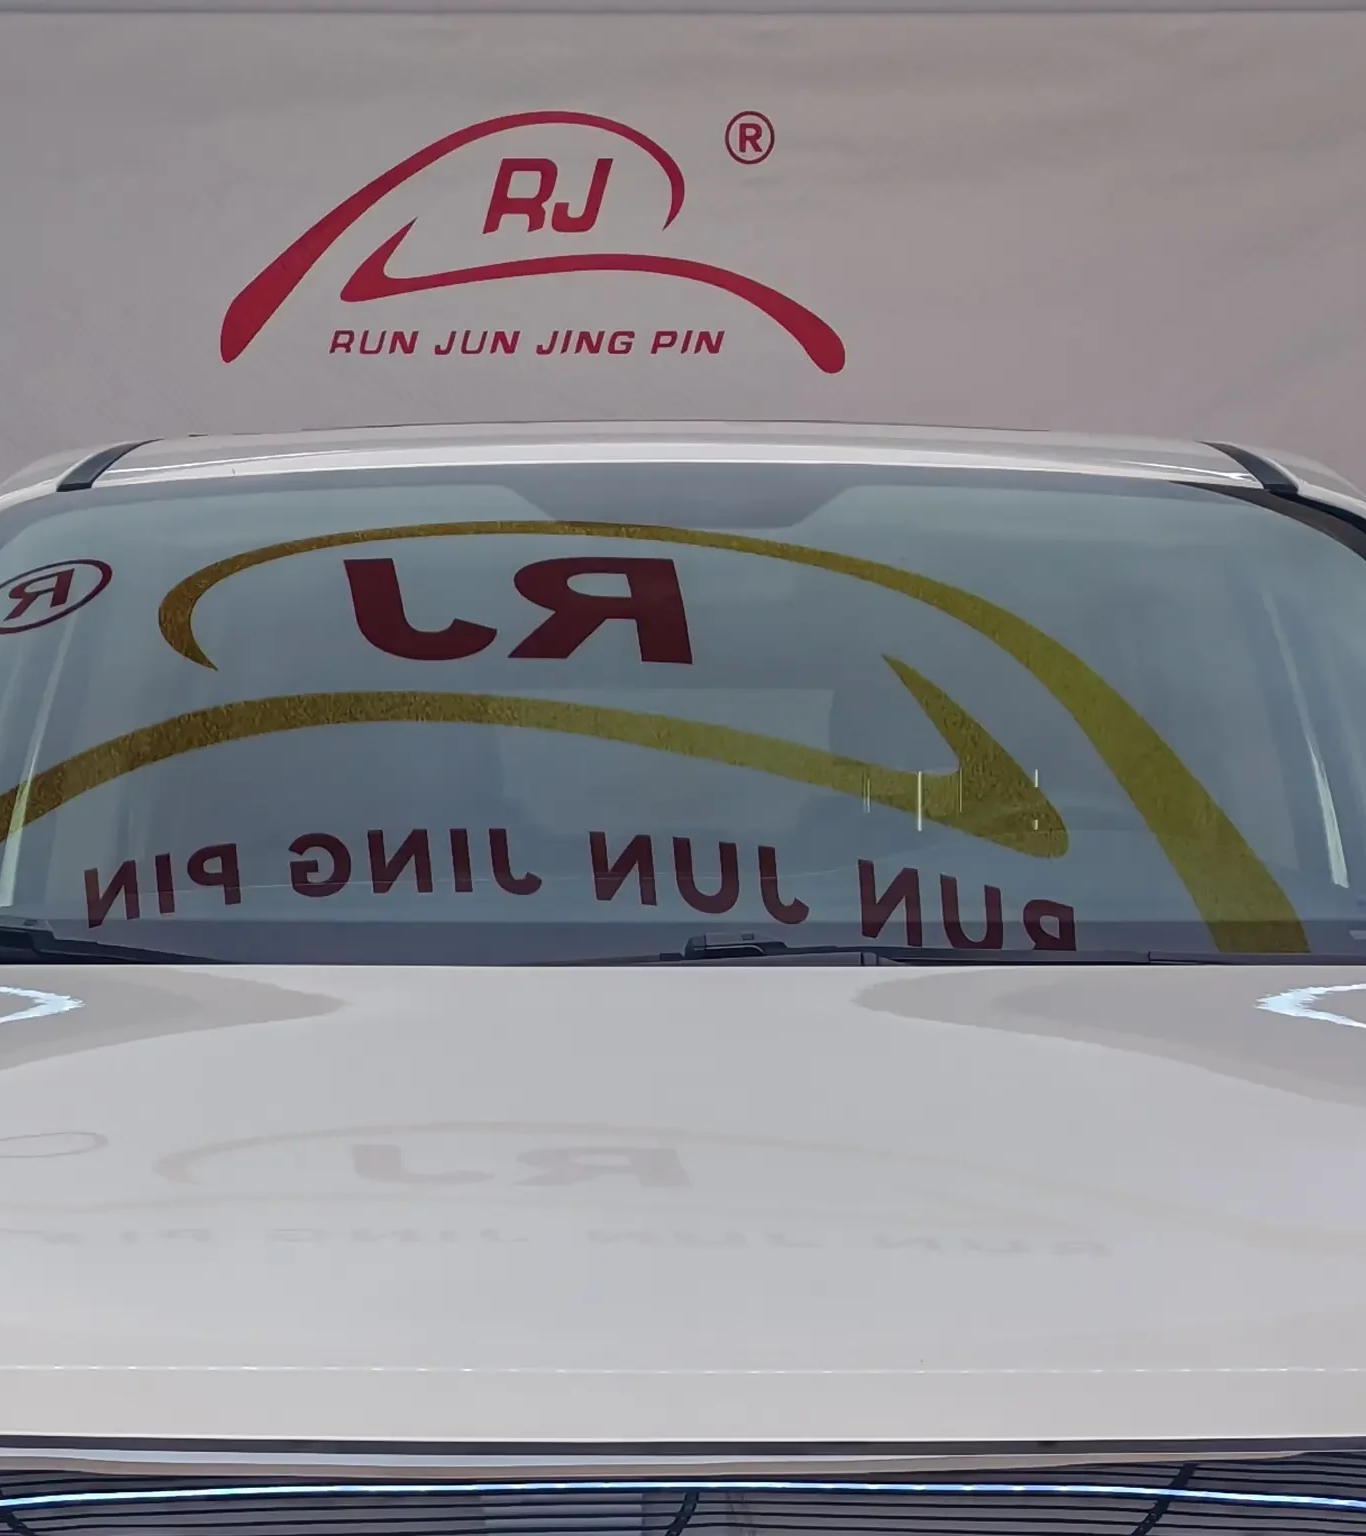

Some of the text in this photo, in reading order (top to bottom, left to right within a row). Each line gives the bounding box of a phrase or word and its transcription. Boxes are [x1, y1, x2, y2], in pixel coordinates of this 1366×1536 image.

[482, 157, 613, 235] RJ
[328, 329, 725, 355] RUN JUN JING PIN
